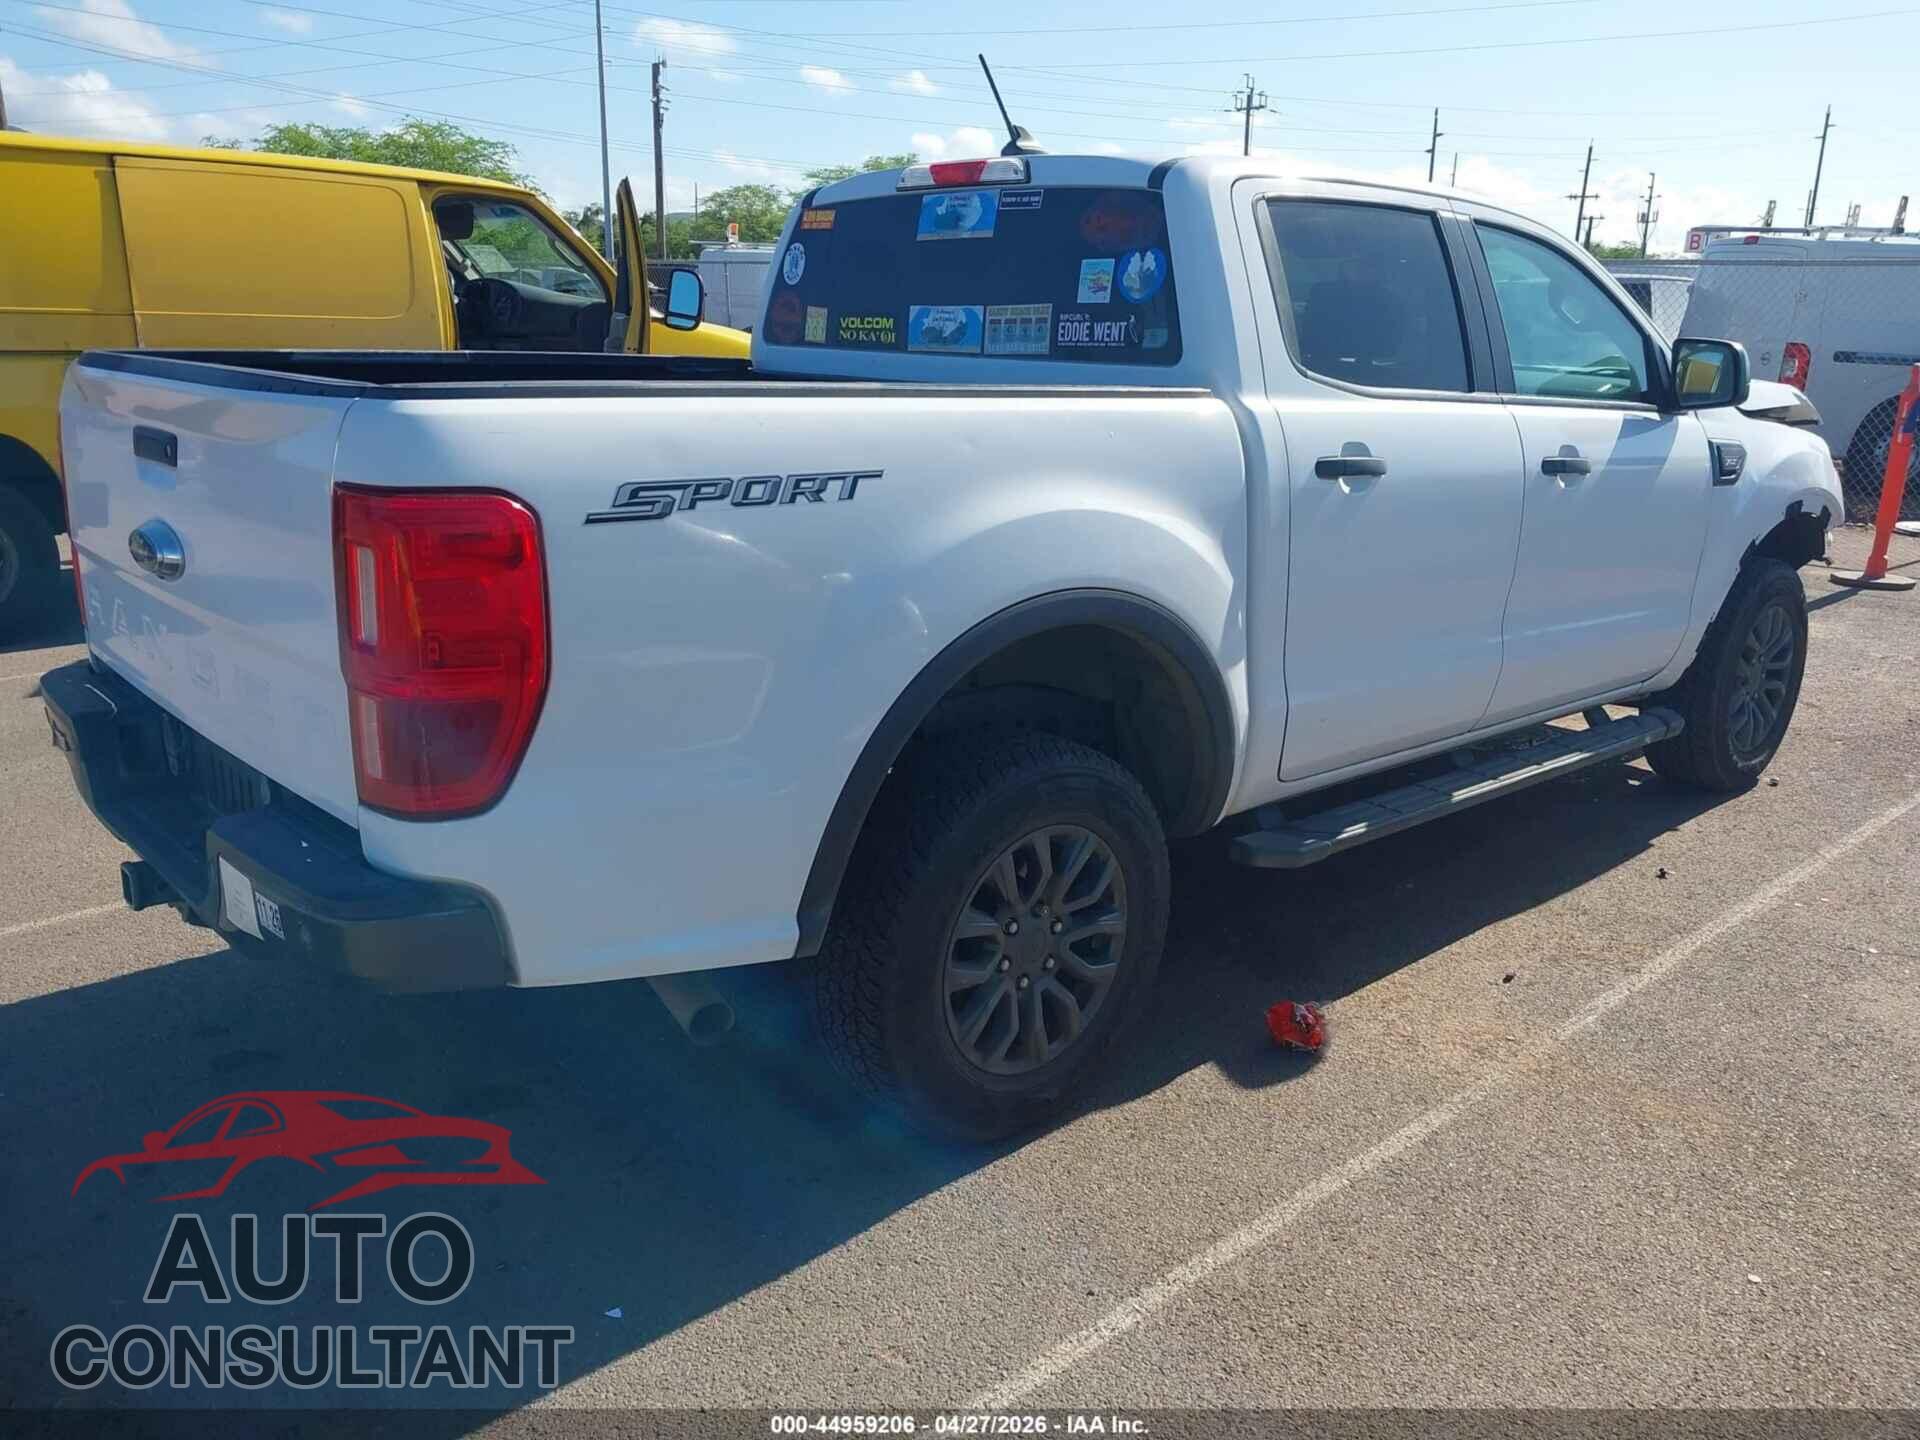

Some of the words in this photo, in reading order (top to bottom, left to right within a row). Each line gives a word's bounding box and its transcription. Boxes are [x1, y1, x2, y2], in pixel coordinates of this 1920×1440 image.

[839, 317, 894, 328] VOLCOM
[1057, 321, 1090, 341] EDDIE
[1093, 321, 1128, 341] WENT
[583, 470, 885, 525] SPORT
